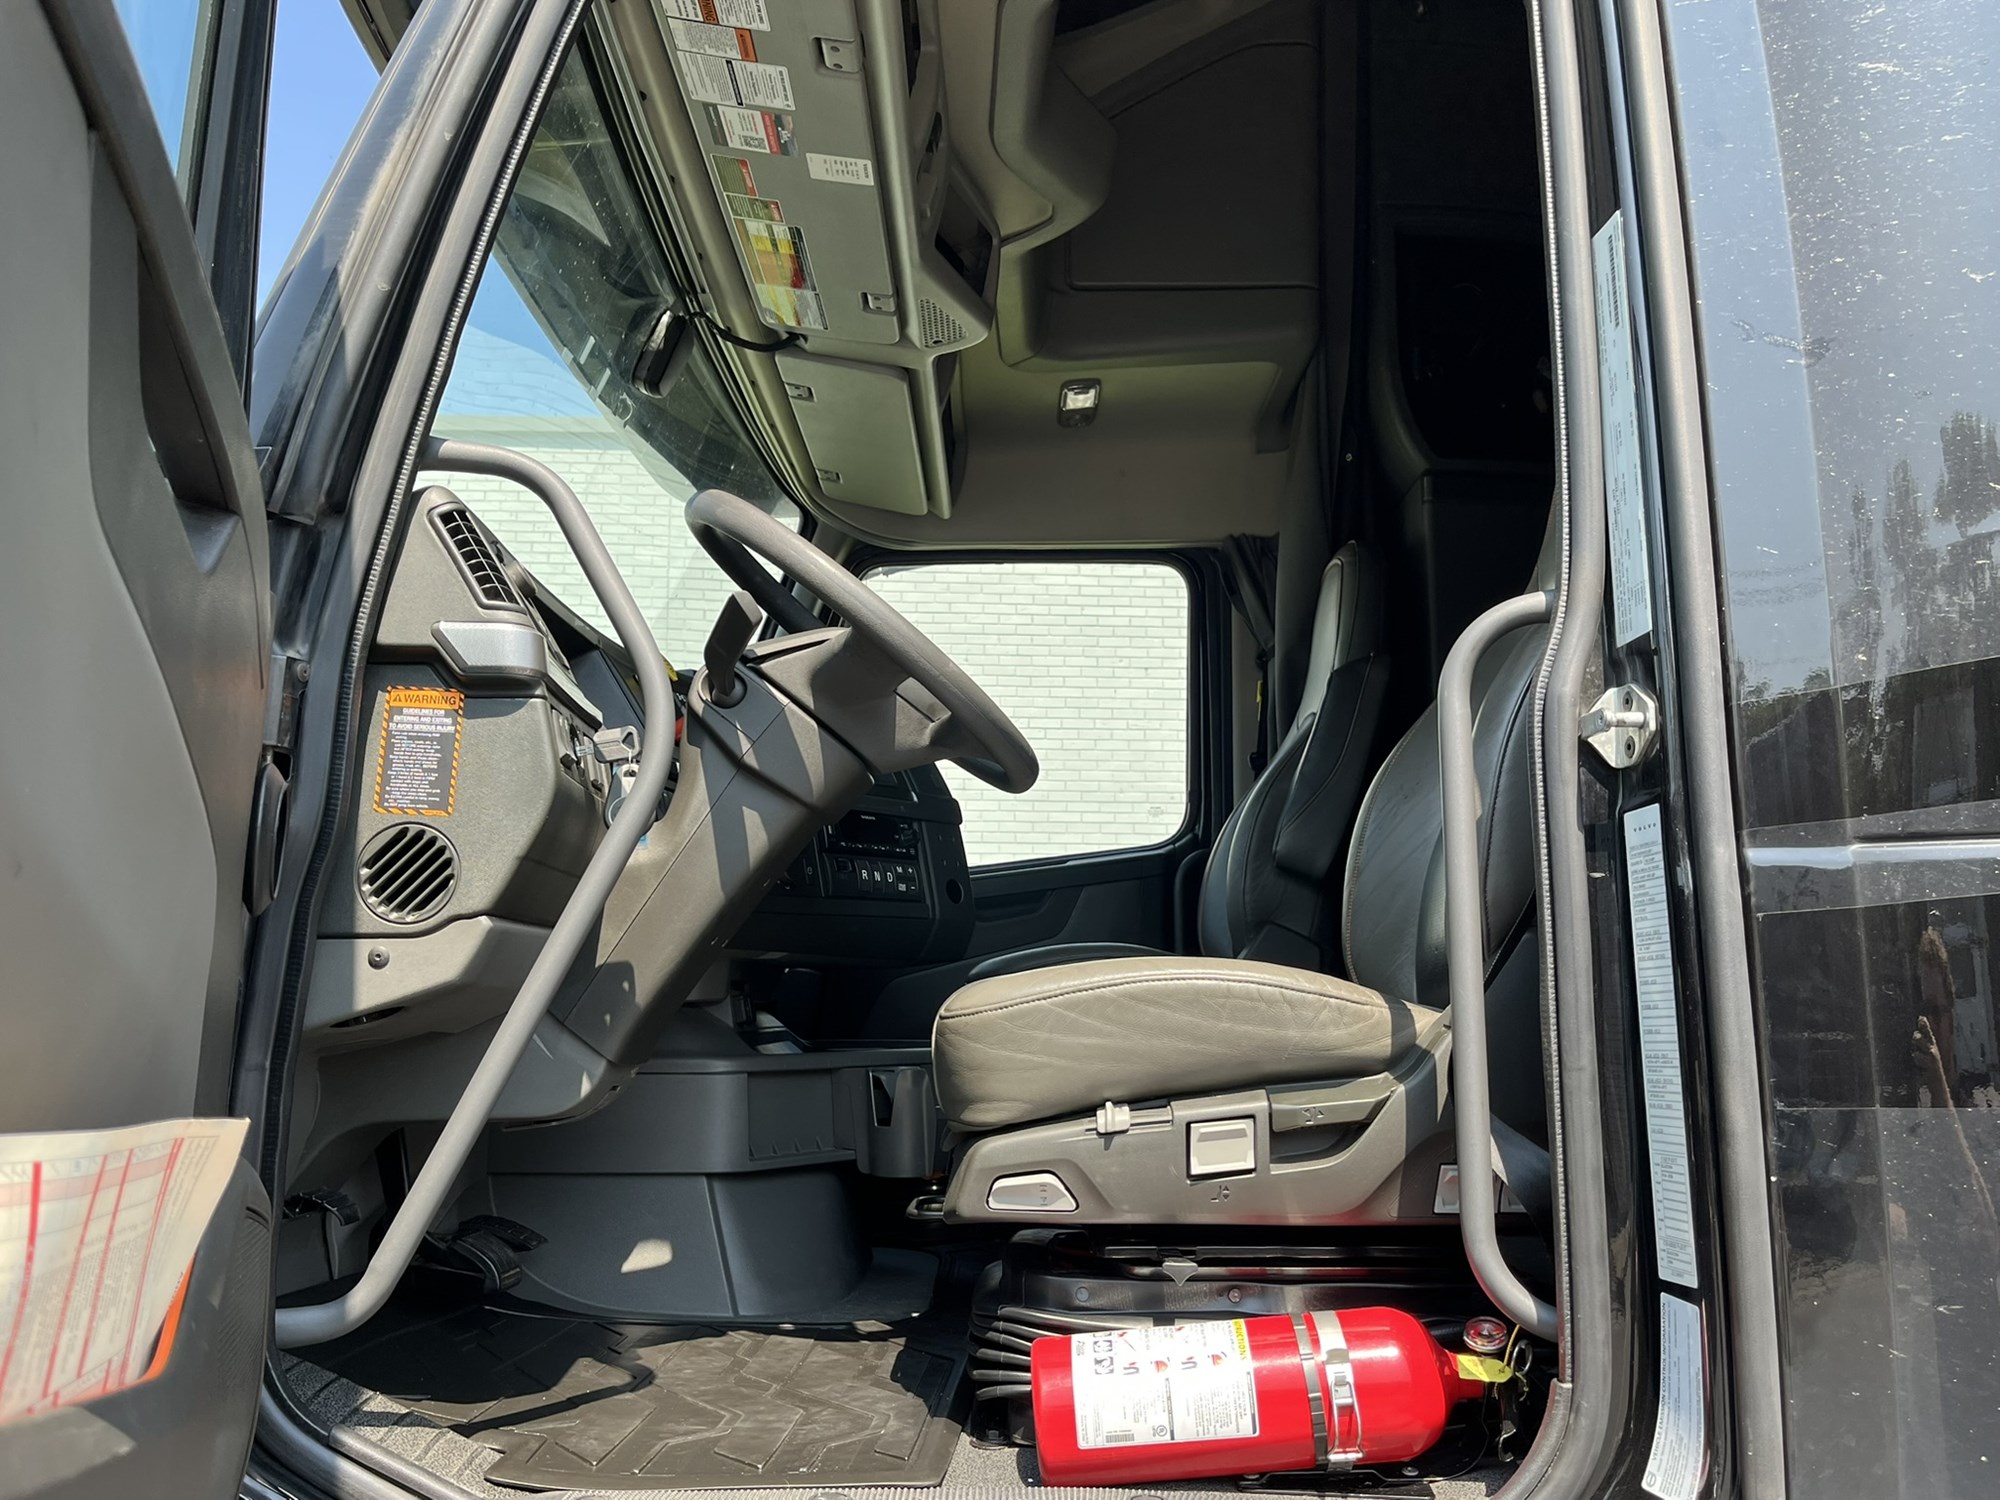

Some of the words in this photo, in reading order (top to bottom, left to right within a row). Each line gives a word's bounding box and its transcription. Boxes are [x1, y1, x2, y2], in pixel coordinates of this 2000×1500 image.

[404, 693, 457, 706] WARNING
[1633, 822, 1656, 832] VOLVO
[861, 870, 868, 880] R
[874, 871, 881, 882] N
[886, 872, 893, 882] D
